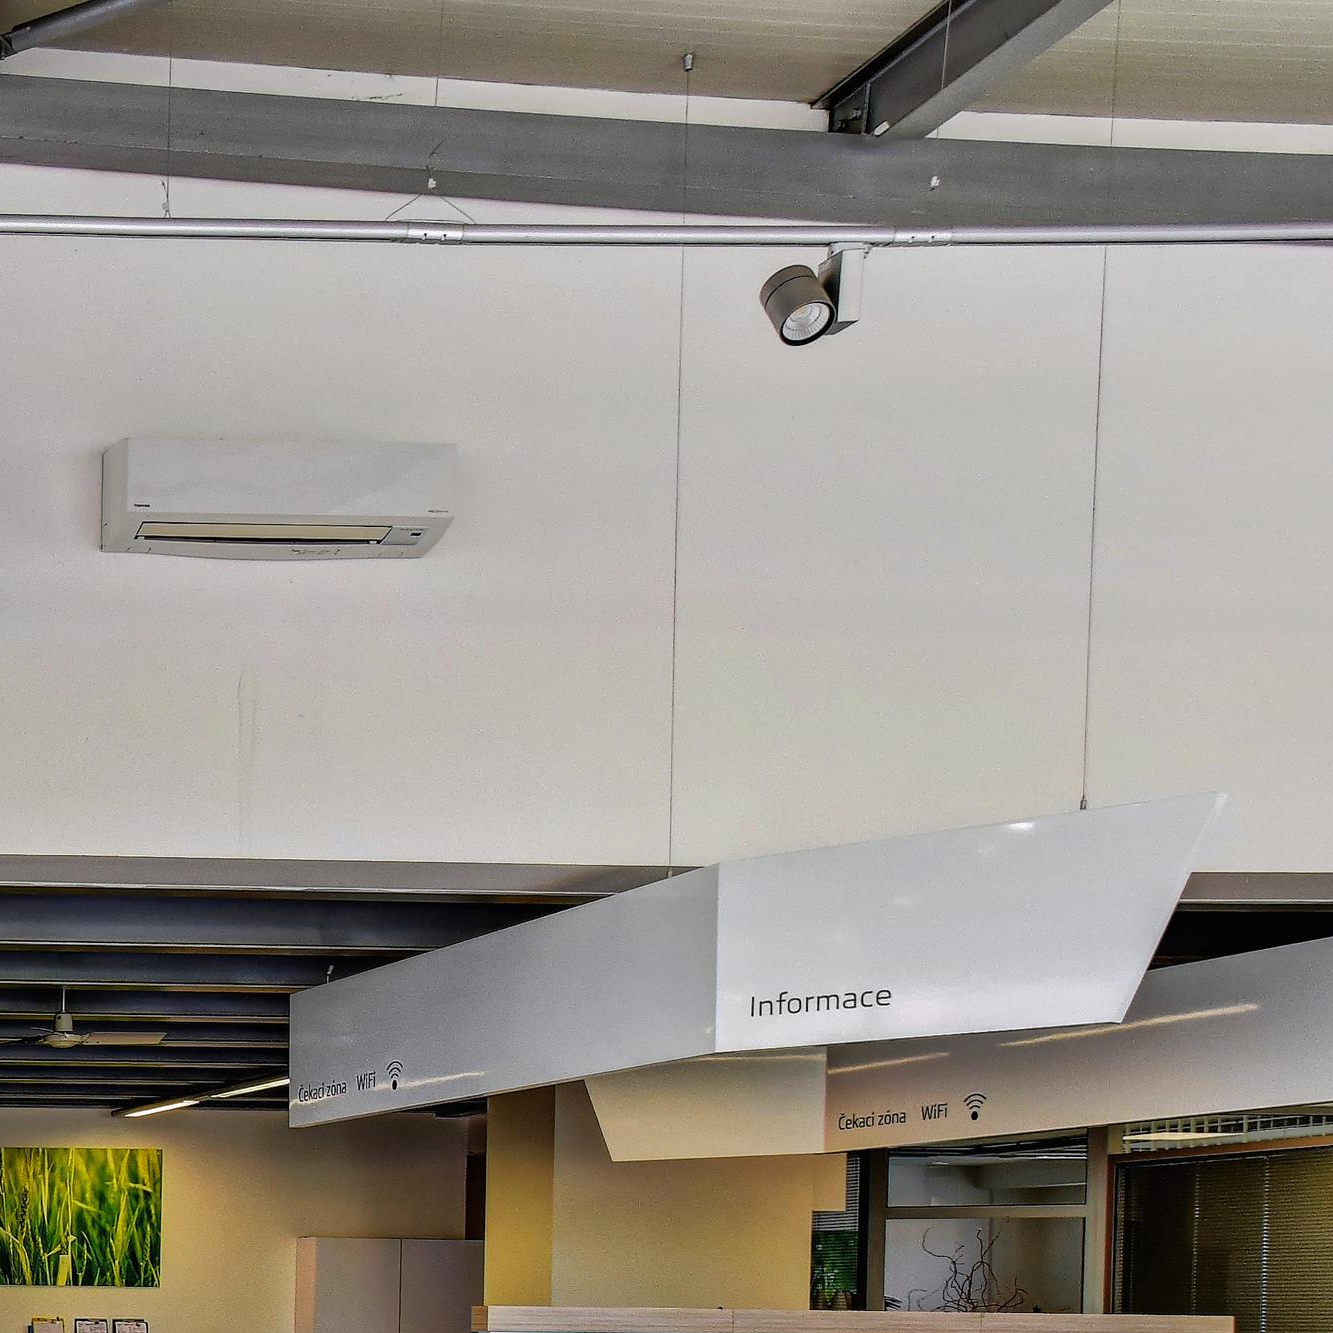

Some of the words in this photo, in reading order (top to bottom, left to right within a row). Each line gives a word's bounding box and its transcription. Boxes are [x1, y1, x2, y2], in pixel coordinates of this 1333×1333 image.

[751, 989, 891, 1017] Informace
[327, 1080, 347, 1096] zóna
[356, 1072, 376, 1091] WiFi
[838, 1112, 874, 1130] Čekací
[878, 1110, 906, 1126] zóna
[921, 1103, 948, 1120] WiFi
